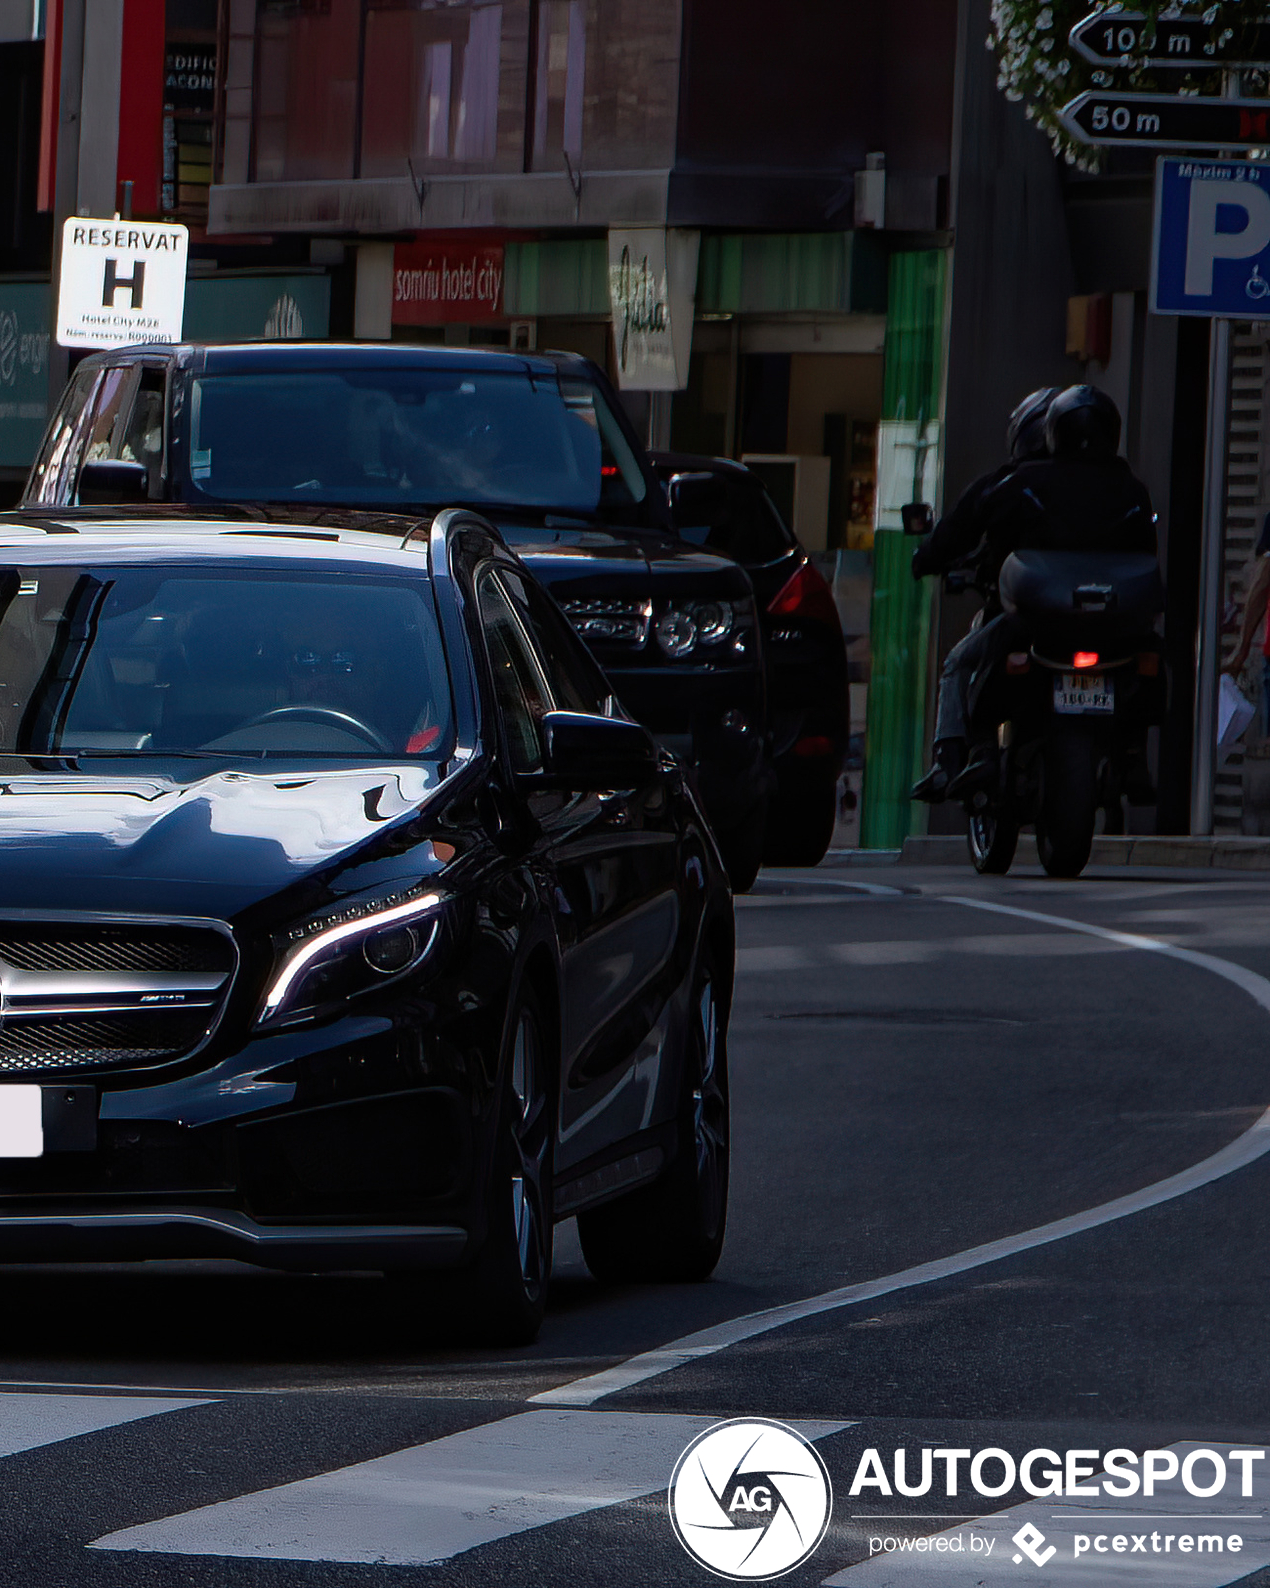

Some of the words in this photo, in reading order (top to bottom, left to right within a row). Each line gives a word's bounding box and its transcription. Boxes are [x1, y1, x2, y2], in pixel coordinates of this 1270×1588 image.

[1168, 34, 1191, 53] m
[1092, 106, 1130, 131] 50
[1136, 114, 1160, 132] m
[73, 227, 182, 251] RESERVAT
[1184, 178, 1270, 296] P
[102, 259, 146, 308] H
[441, 256, 476, 301] hotel
[477, 259, 502, 311] city
[82, 313, 111, 325] Hotel
[113, 316, 135, 328] City
